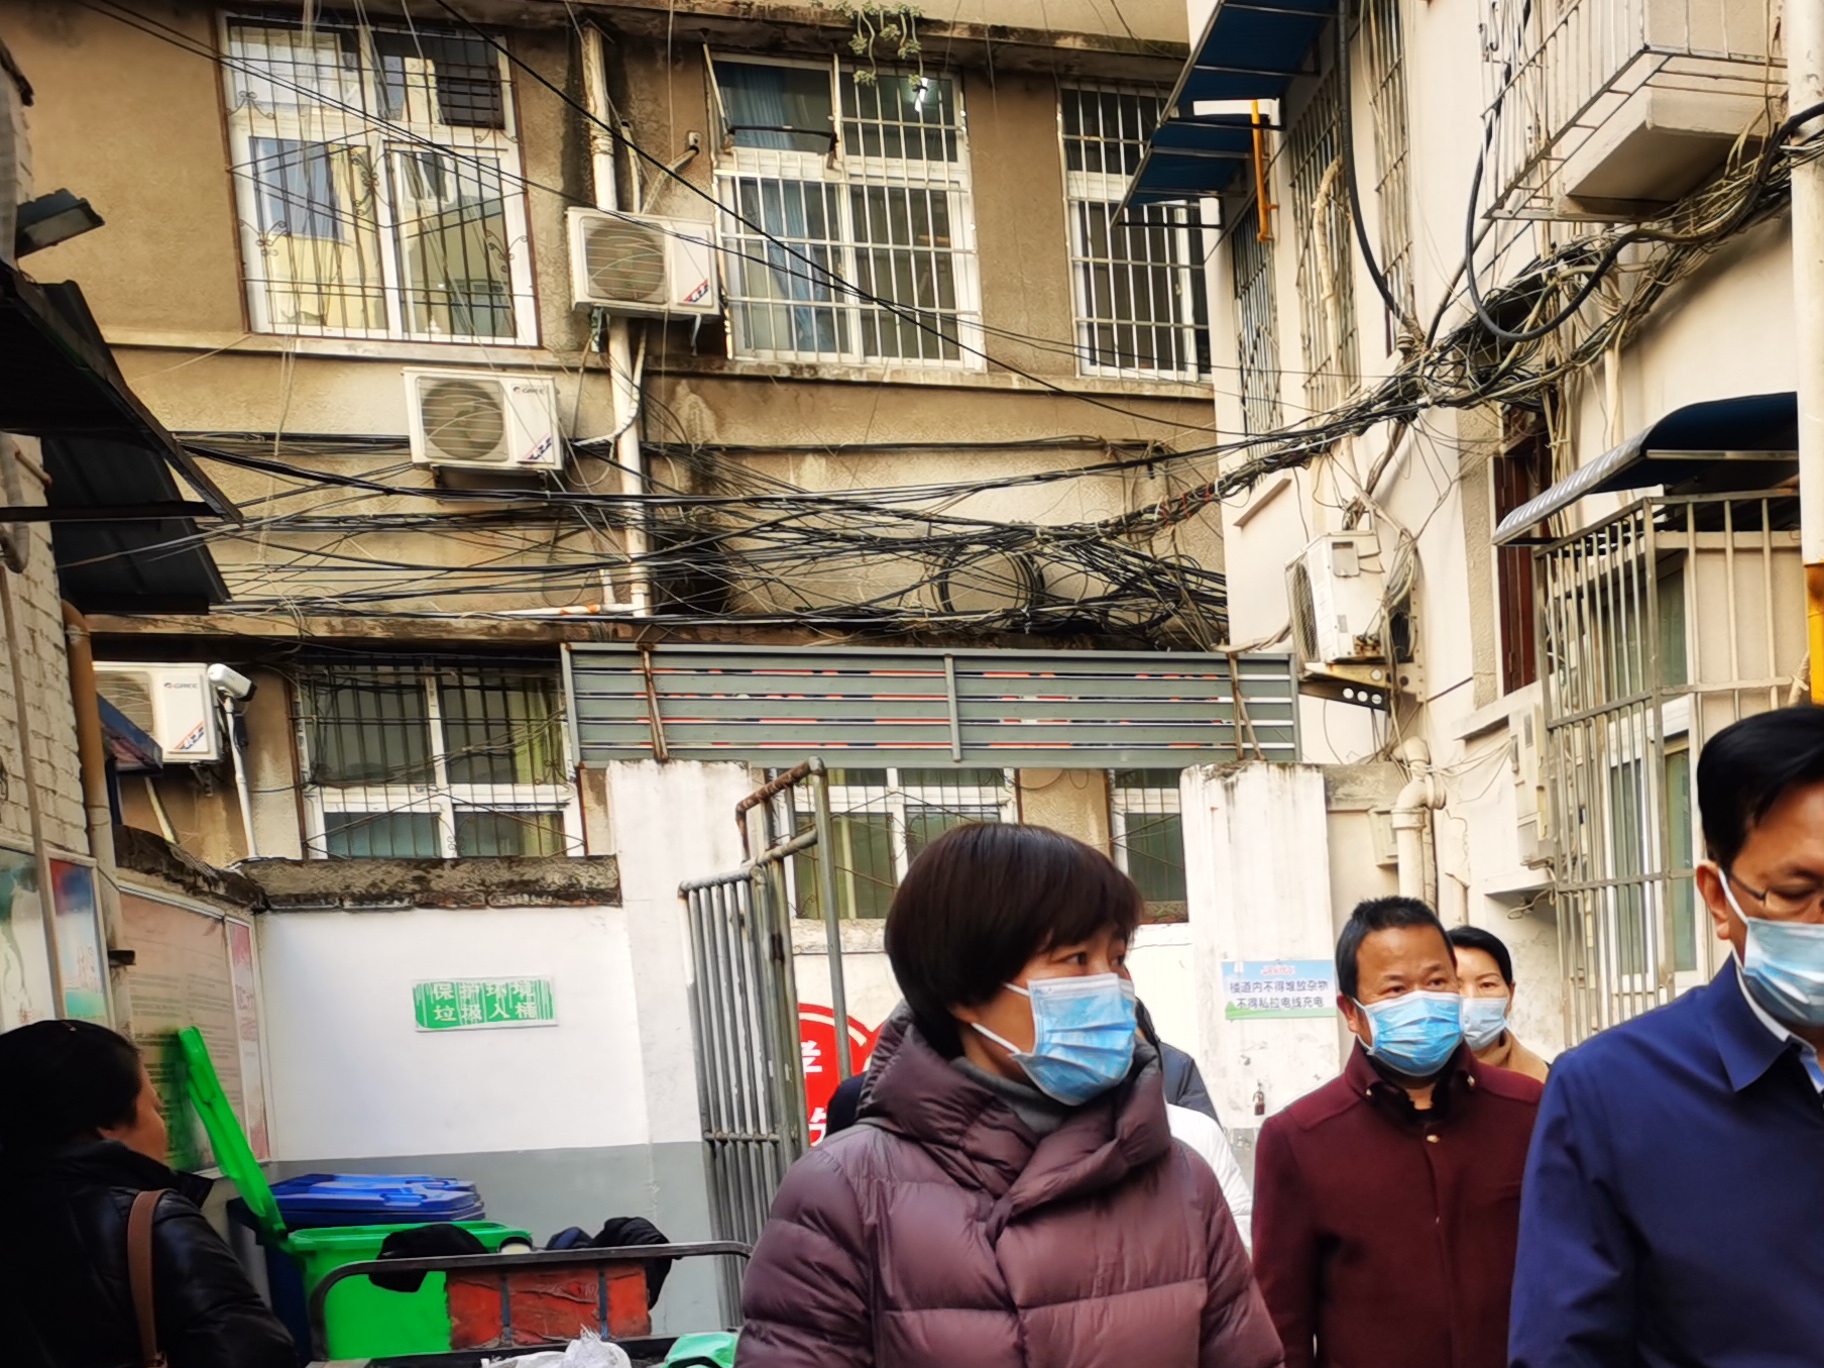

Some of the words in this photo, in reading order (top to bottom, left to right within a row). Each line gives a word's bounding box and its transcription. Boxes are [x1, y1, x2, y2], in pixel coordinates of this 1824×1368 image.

[1229, 980, 1329, 994] 楼道内不得堆放杂物
[1236, 996, 1325, 1009] 不得私拉电线充电
